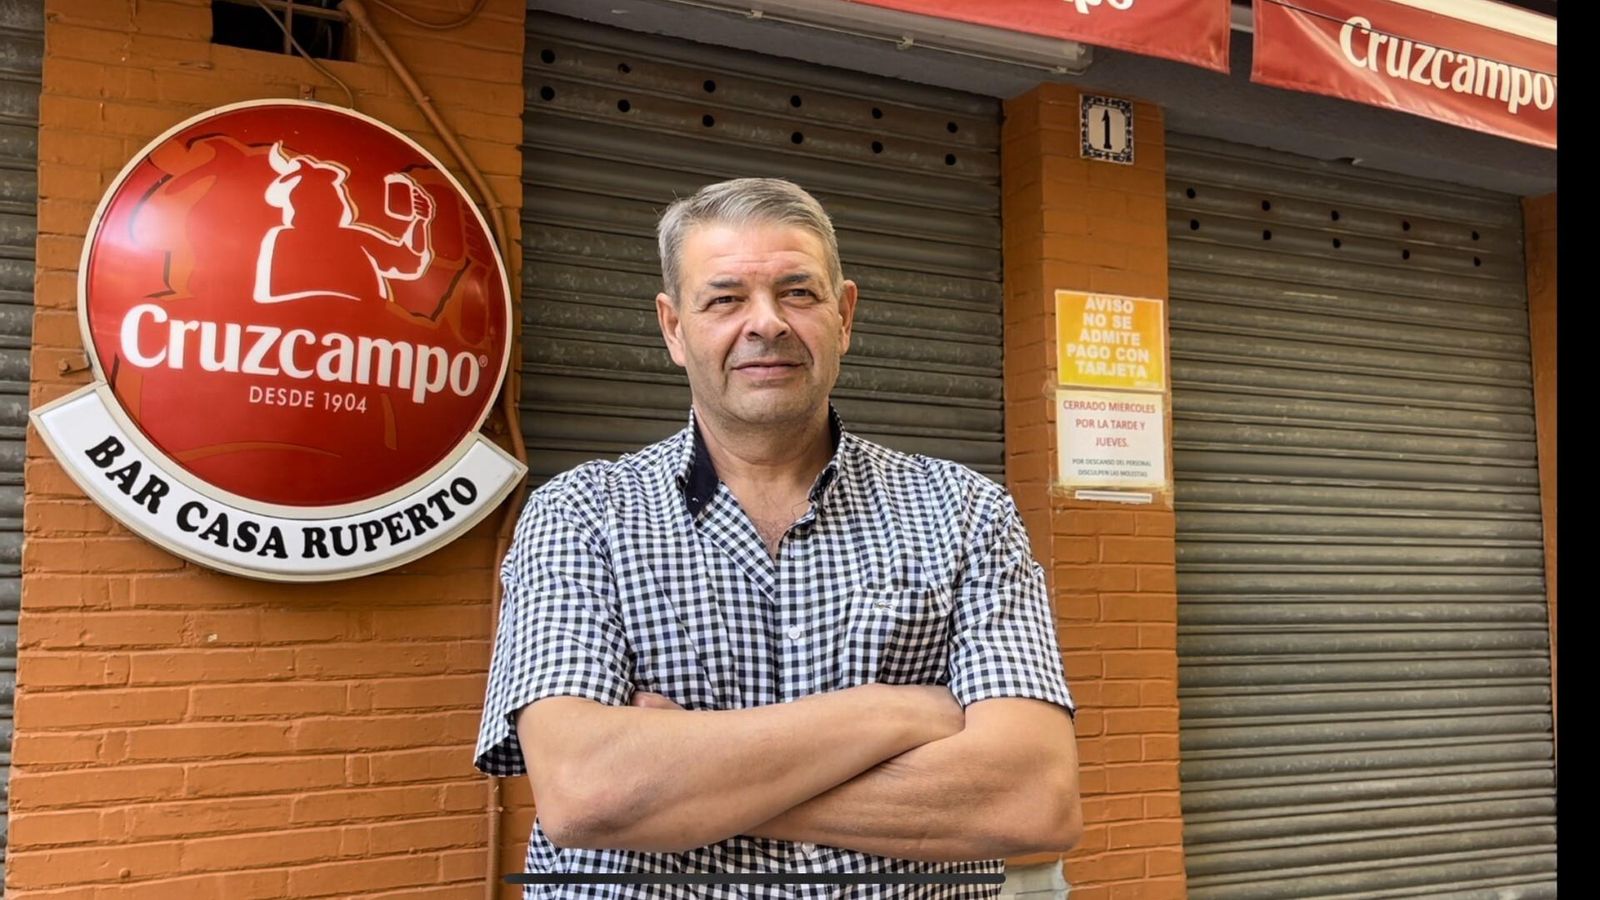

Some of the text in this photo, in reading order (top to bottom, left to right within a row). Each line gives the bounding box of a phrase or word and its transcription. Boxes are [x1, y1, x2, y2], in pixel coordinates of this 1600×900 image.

[1339, 16, 1555, 114] Cruzcampo
[1100, 108, 1114, 150] 1
[1085, 296, 1134, 314] AVISO
[1083, 312, 1132, 330] NO SE
[1079, 329, 1141, 346] ADMITE
[1066, 343, 1150, 363] PAGO CON
[1075, 360, 1148, 379] TARJETA
[249, 385, 367, 414] DESDE 1904
[1063, 400, 1156, 414] CERRADO MIERCOLES
[1075, 418, 1146, 431] POR LA TARDE Y
[1096, 437, 1129, 448] JUEVES.
[1085, 458, 1115, 466] DESCANSO
[84, 435, 478, 559] BAR CASA RUPERTO
